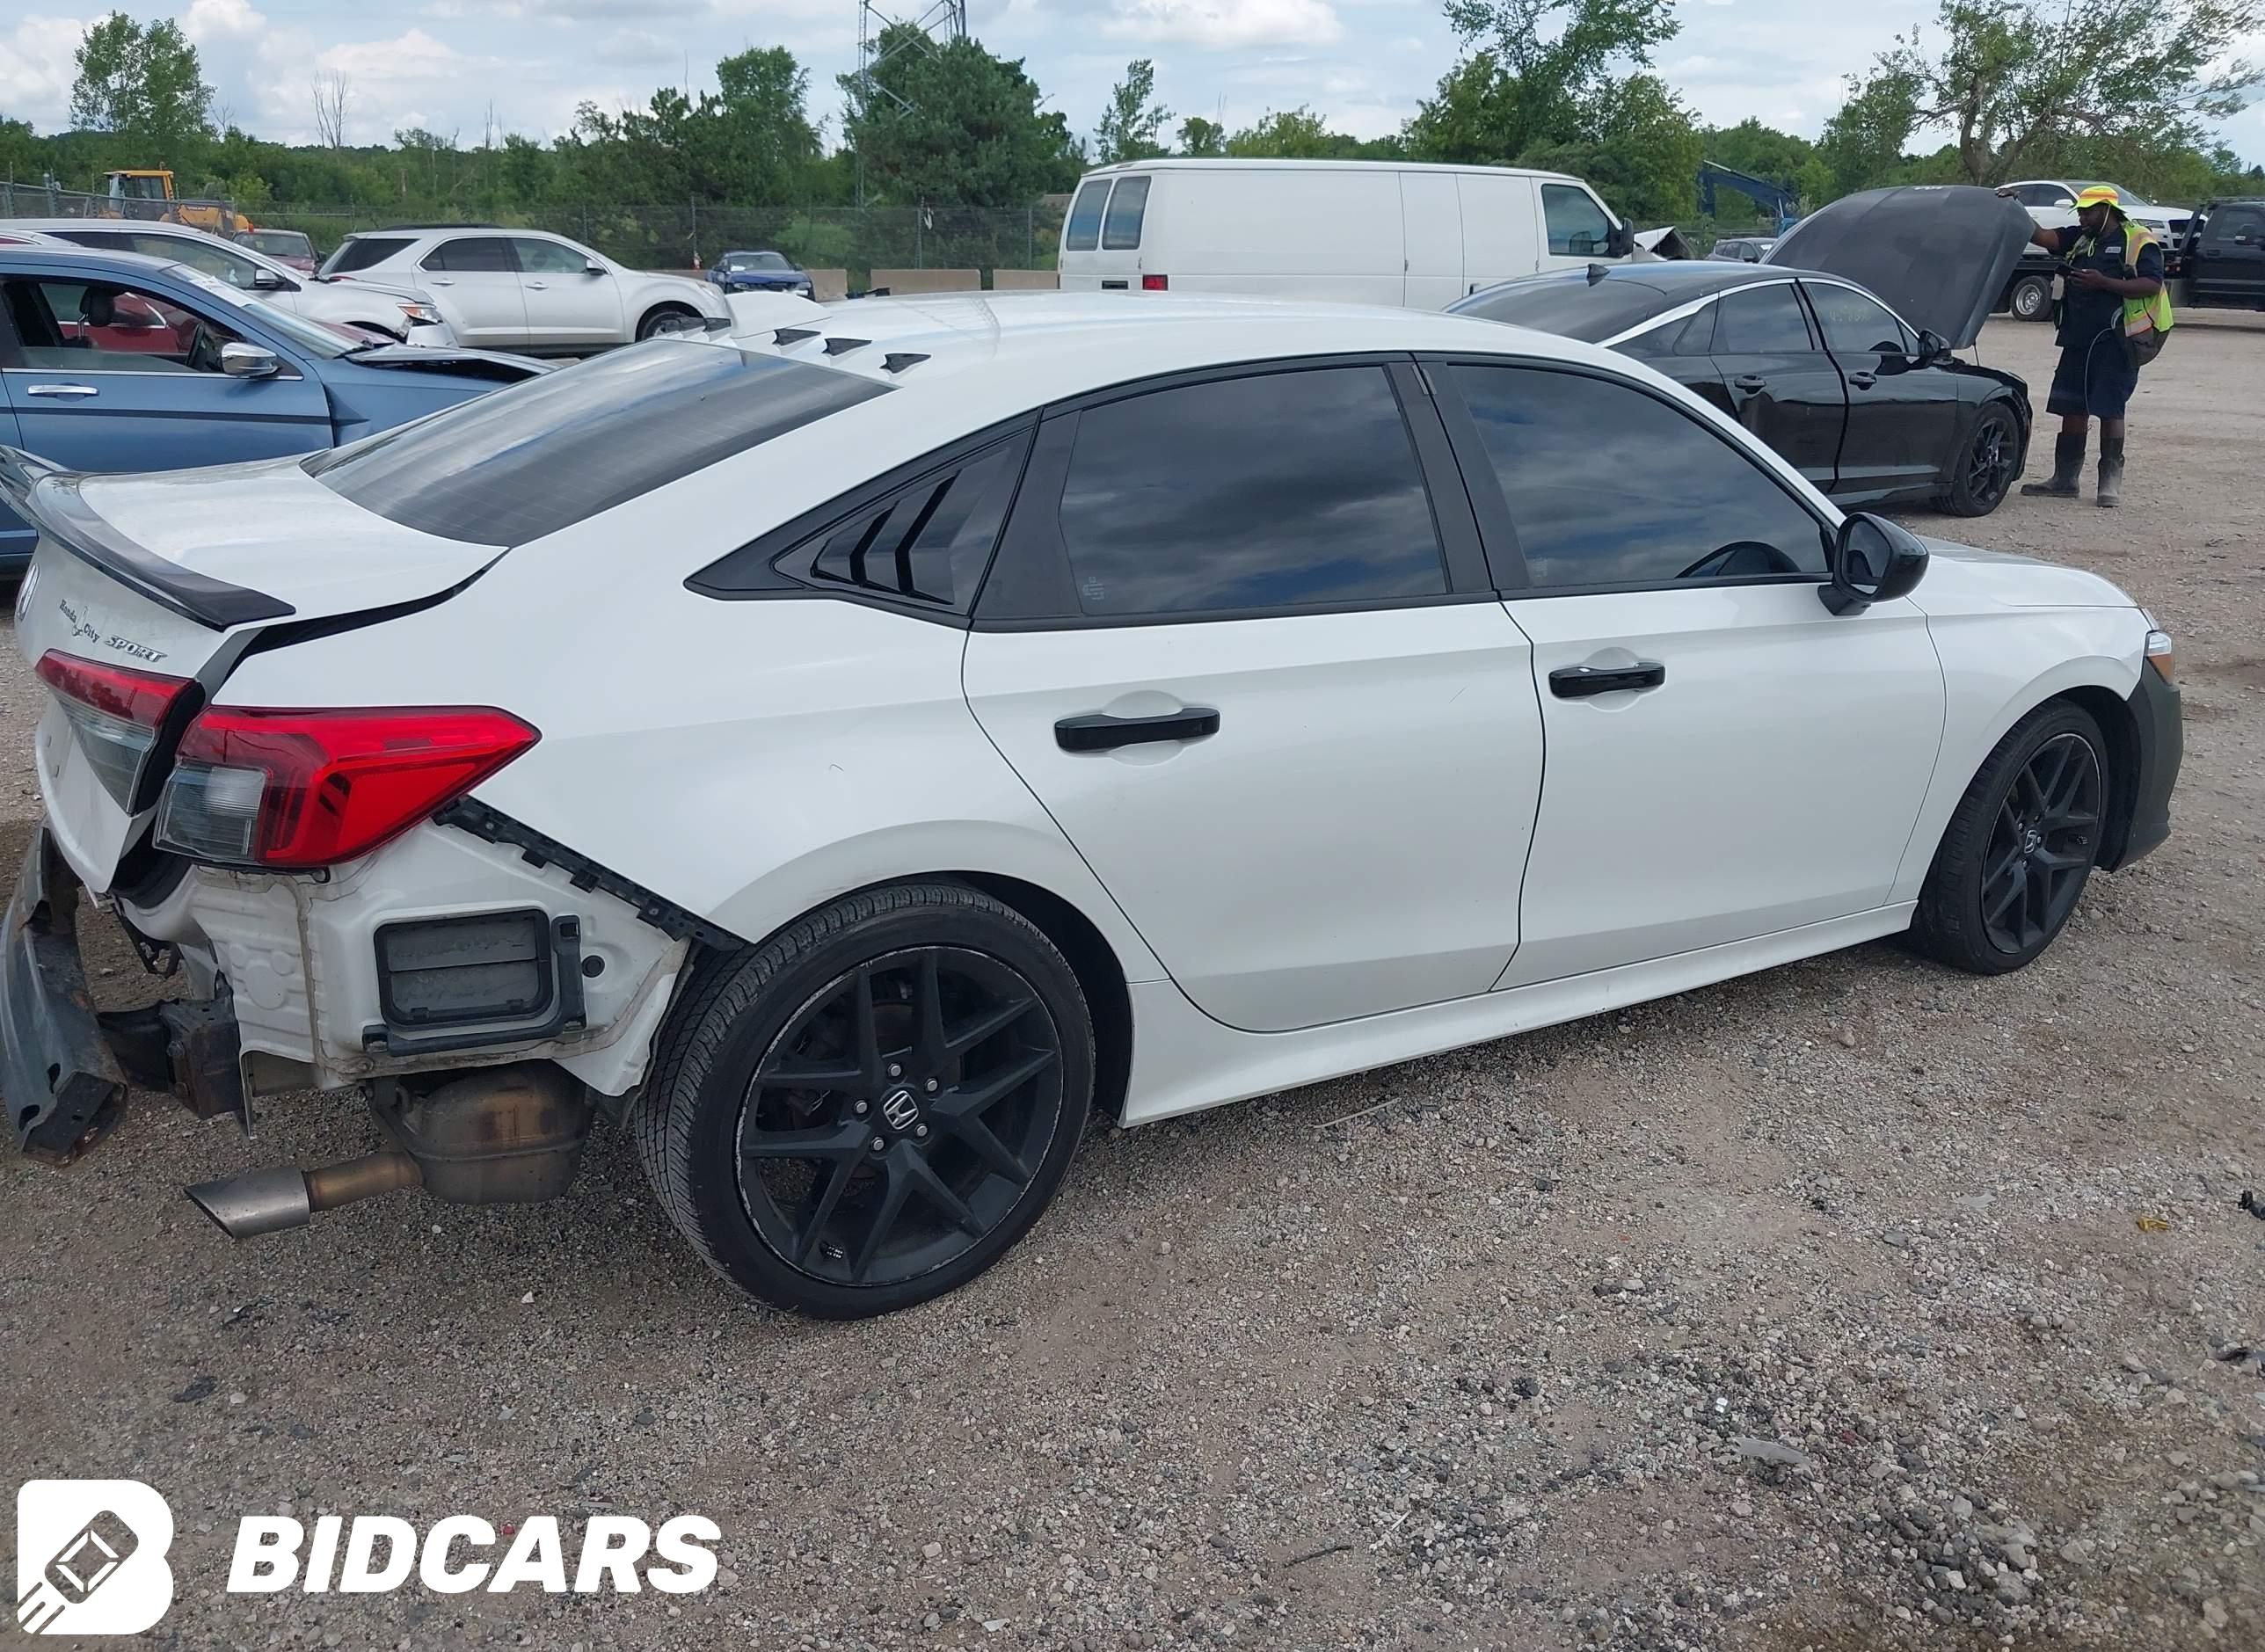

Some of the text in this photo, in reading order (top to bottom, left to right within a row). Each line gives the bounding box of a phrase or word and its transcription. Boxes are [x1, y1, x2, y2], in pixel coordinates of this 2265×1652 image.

[59, 599, 100, 643] Honda City
[104, 635, 168, 662] SPORT
